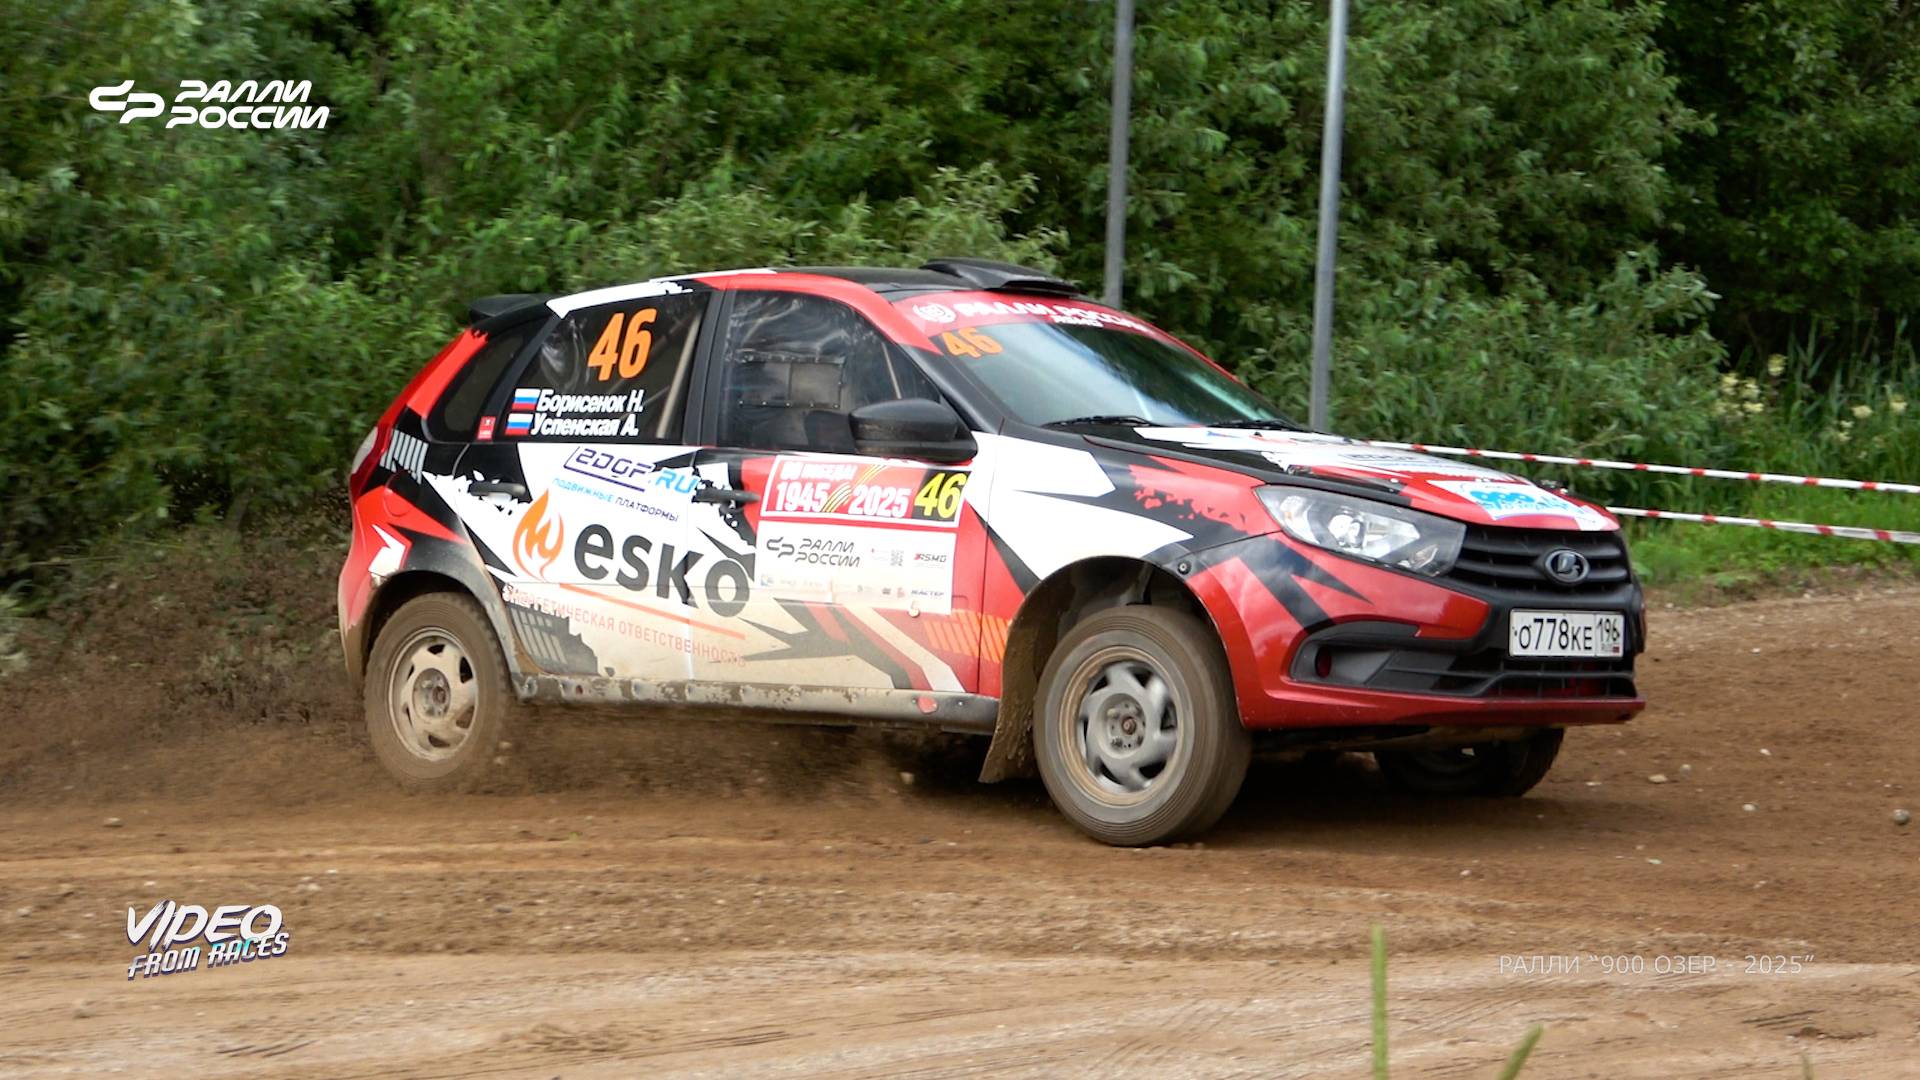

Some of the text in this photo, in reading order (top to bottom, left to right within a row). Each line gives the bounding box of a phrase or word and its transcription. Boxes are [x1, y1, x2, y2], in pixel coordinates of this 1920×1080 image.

[588, 307, 657, 381] 46
[941, 327, 1004, 358] 46
[536, 389, 645, 417] Борисенок Н.
[530, 412, 640, 436] Успенская А.
[552, 478, 679, 522] ПОДВИЖНЫЕ ПЛАТФОРМЫ
[776, 482, 912, 518] 1945 2025
[914, 473, 967, 518] 46
[795, 551, 860, 567] РОССИИ
[799, 538, 855, 552] РАЛЛИ
[574, 523, 750, 618] esko
